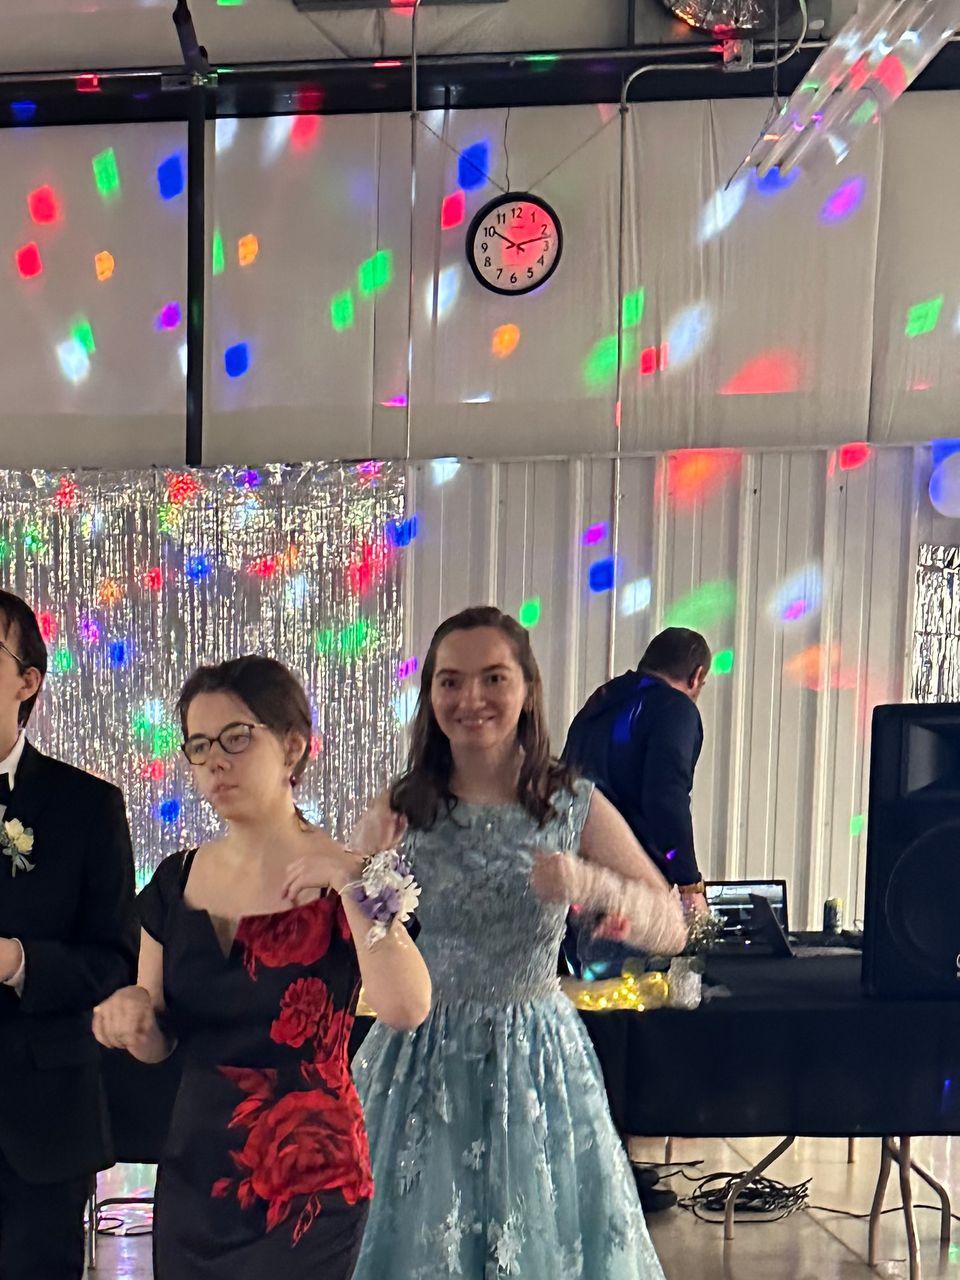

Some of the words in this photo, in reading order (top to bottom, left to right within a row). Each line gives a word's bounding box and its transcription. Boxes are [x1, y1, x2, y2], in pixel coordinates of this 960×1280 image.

[496, 213, 506, 224] 11
[512, 207, 522, 219] 12
[531, 211, 536, 223] 1
[484, 226, 496, 238] 10
[541, 224, 548, 235] 2
[481, 242, 488, 254] 9
[544, 241, 549, 252] 3
[484, 256, 492, 268] 8
[537, 255, 544, 266] 4
[496, 268, 503, 280] 7
[510, 272, 518, 284] 6
[527, 268, 534, 278] 5
